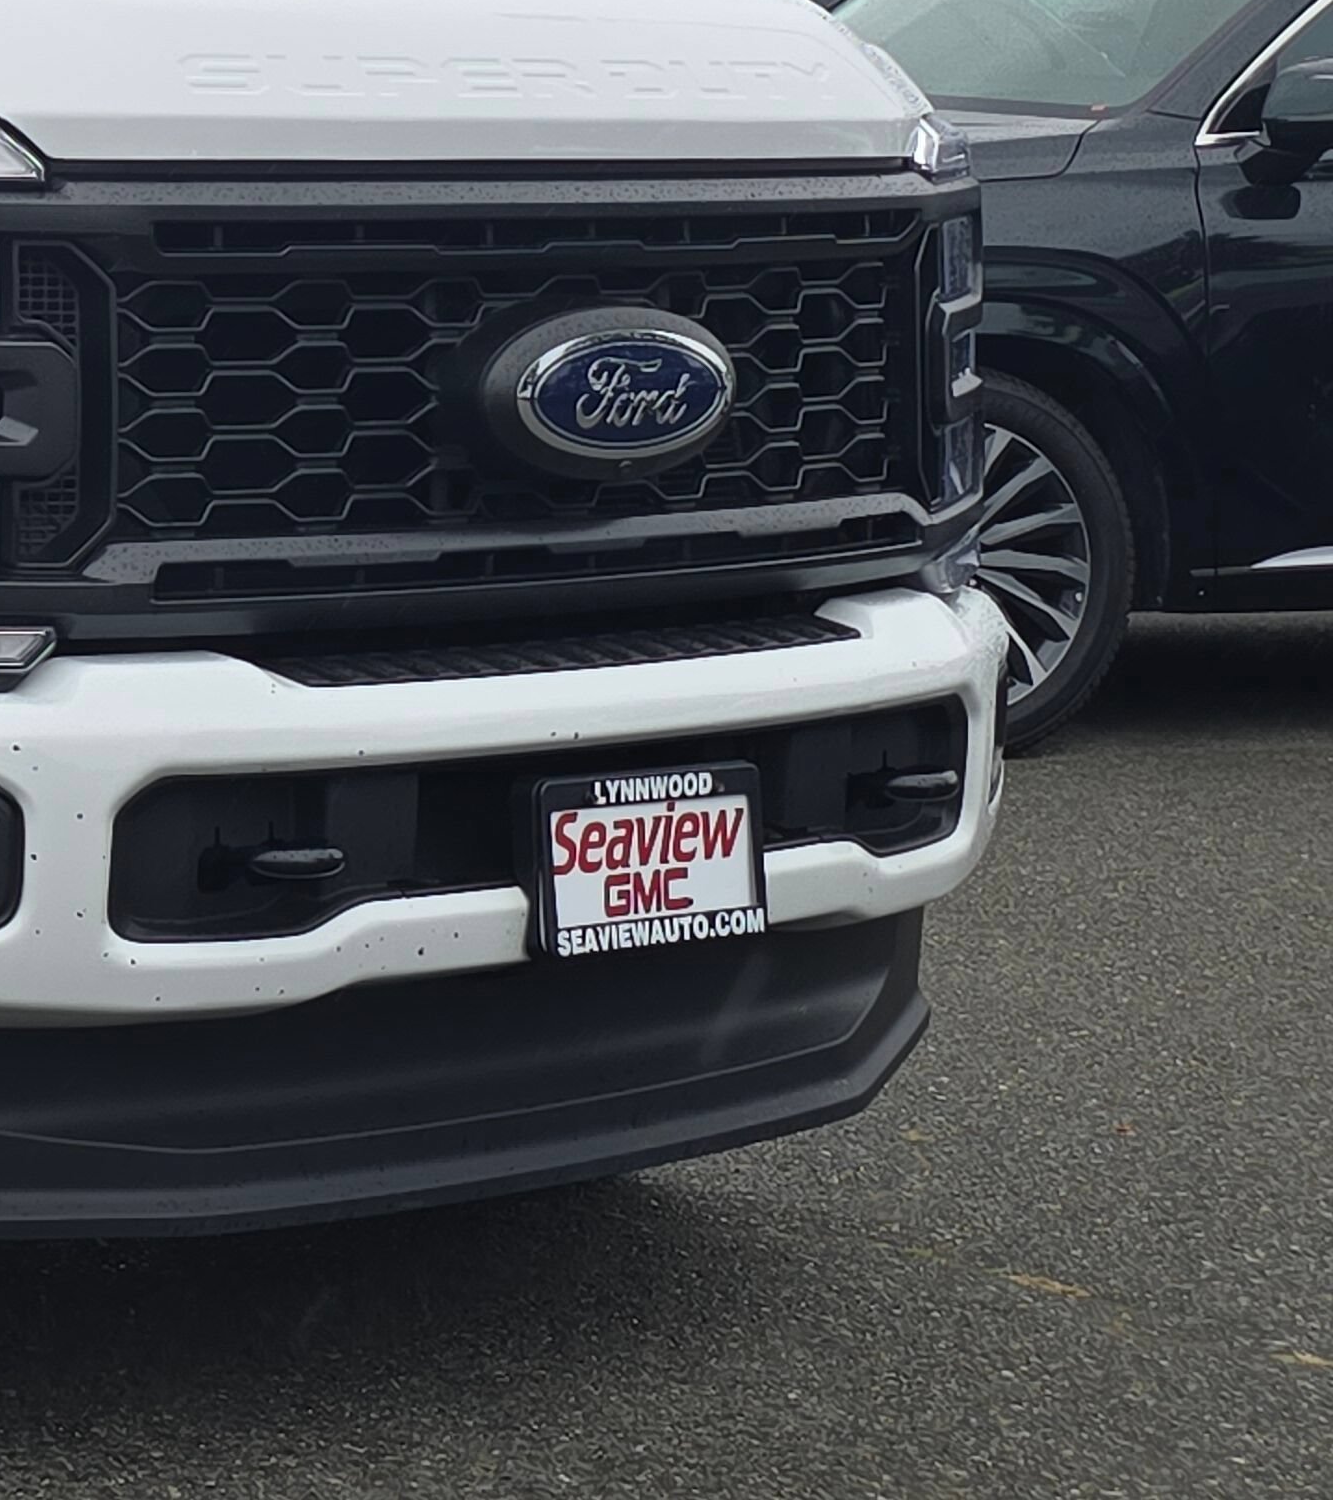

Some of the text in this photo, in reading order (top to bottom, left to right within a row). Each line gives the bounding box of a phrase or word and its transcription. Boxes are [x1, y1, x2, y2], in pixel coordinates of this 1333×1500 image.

[176, 53, 835, 101] SUPER DUTY
[575, 356, 691, 429] Ford
[593, 771, 713, 805] LYNNWOOD
[552, 800, 744, 876] Seaview
[603, 866, 694, 919] GMC
[556, 907, 766, 957] SEAVIEWAUTO.COM
